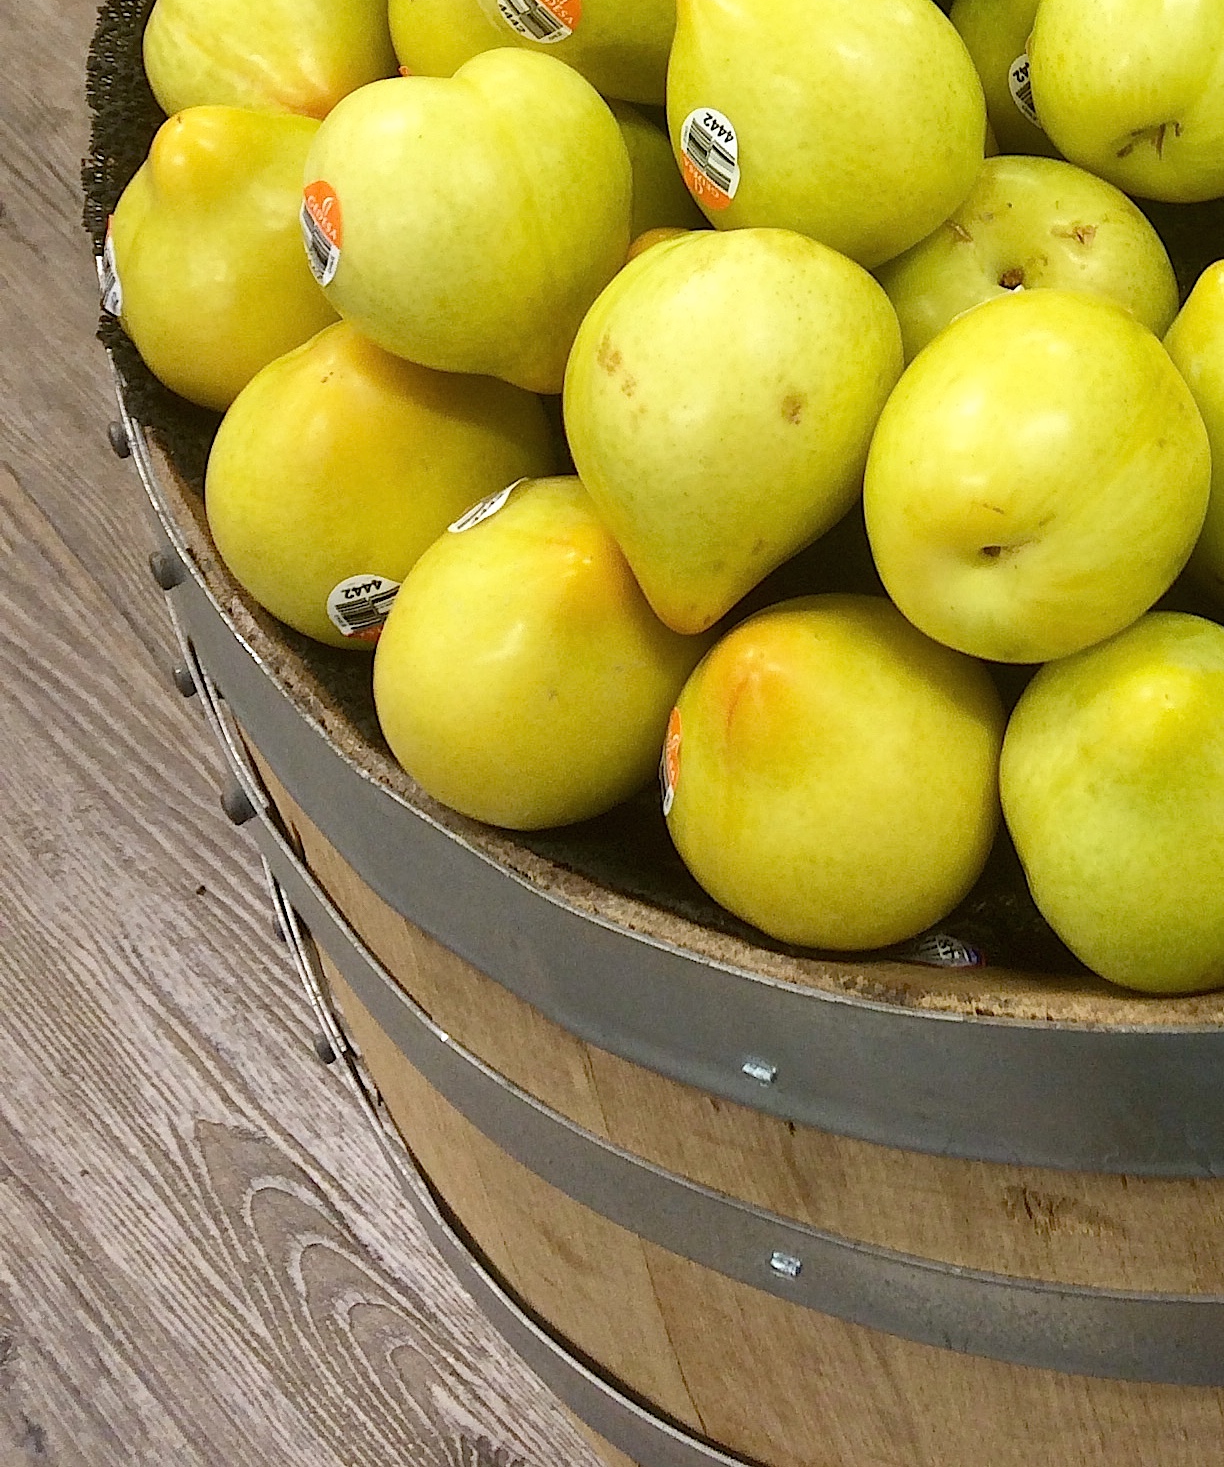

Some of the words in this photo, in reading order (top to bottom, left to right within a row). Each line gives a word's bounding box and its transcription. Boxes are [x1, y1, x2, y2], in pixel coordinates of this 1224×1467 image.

[498, 3, 527, 34] 4442
[703, 112, 736, 144] 4442
[341, 579, 384, 600] 4442
